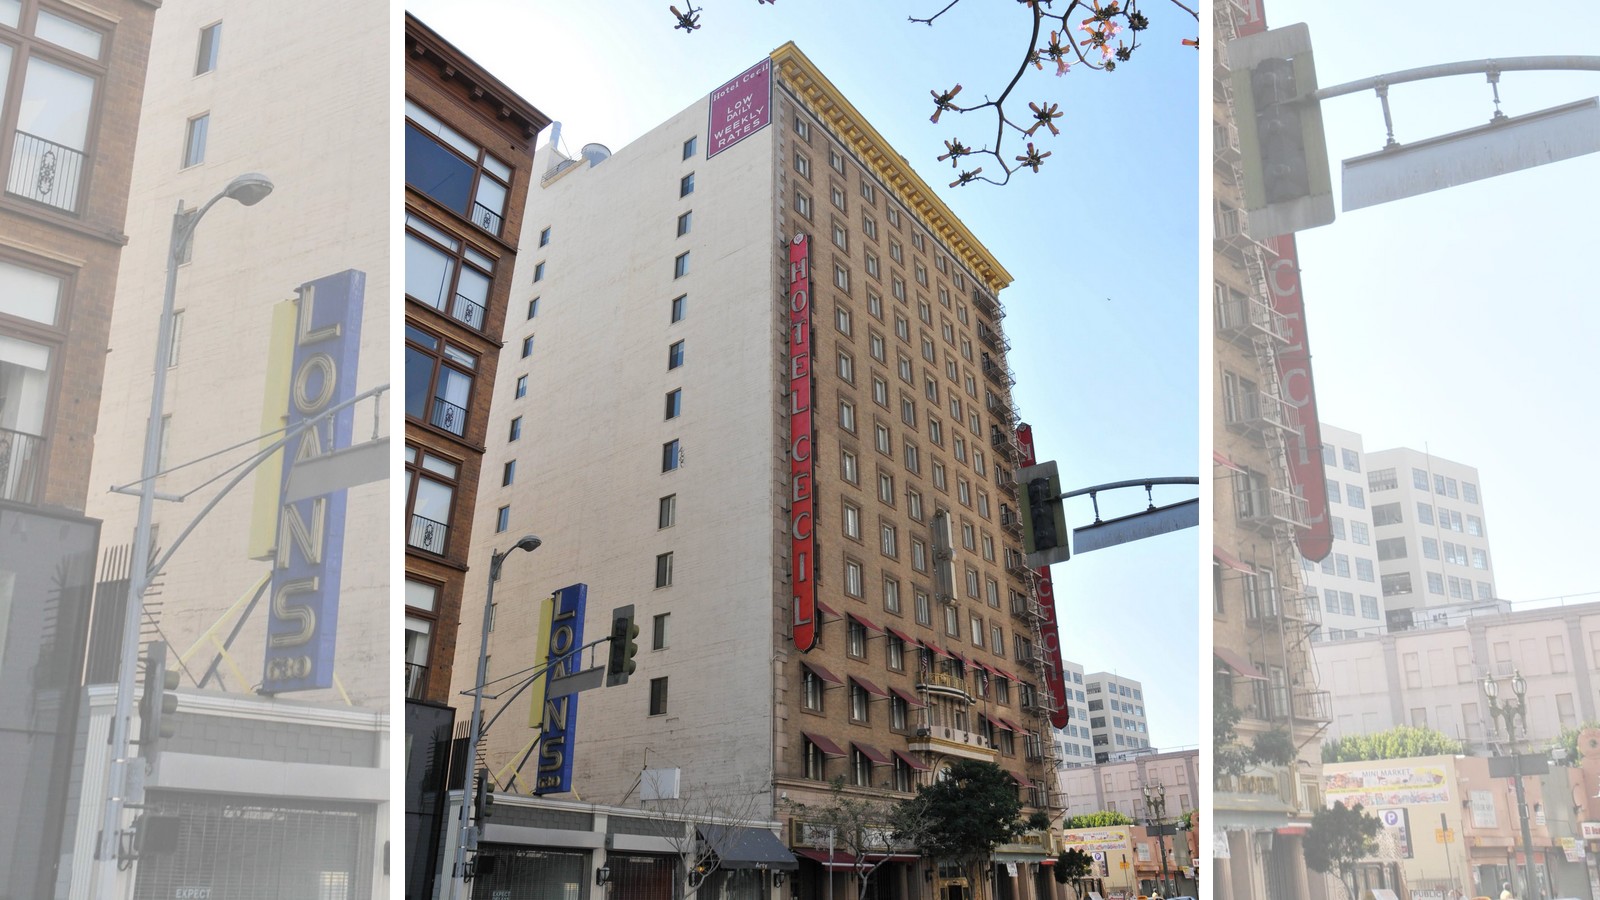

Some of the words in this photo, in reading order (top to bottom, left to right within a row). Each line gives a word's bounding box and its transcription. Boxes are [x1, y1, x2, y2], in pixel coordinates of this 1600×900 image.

[713, 81, 739, 102] Hotel
[743, 62, 769, 83] Cecil
[726, 102, 752, 122] DAILY
[727, 93, 754, 114] LOW
[714, 105, 765, 140] WEEKLY
[718, 118, 761, 148] RATES
[790, 256, 809, 415] HOTEL
[791, 434, 811, 626] CECIL
[1380, 767, 1411, 777] MARKET
[175, 886, 212, 899] EXPECT
